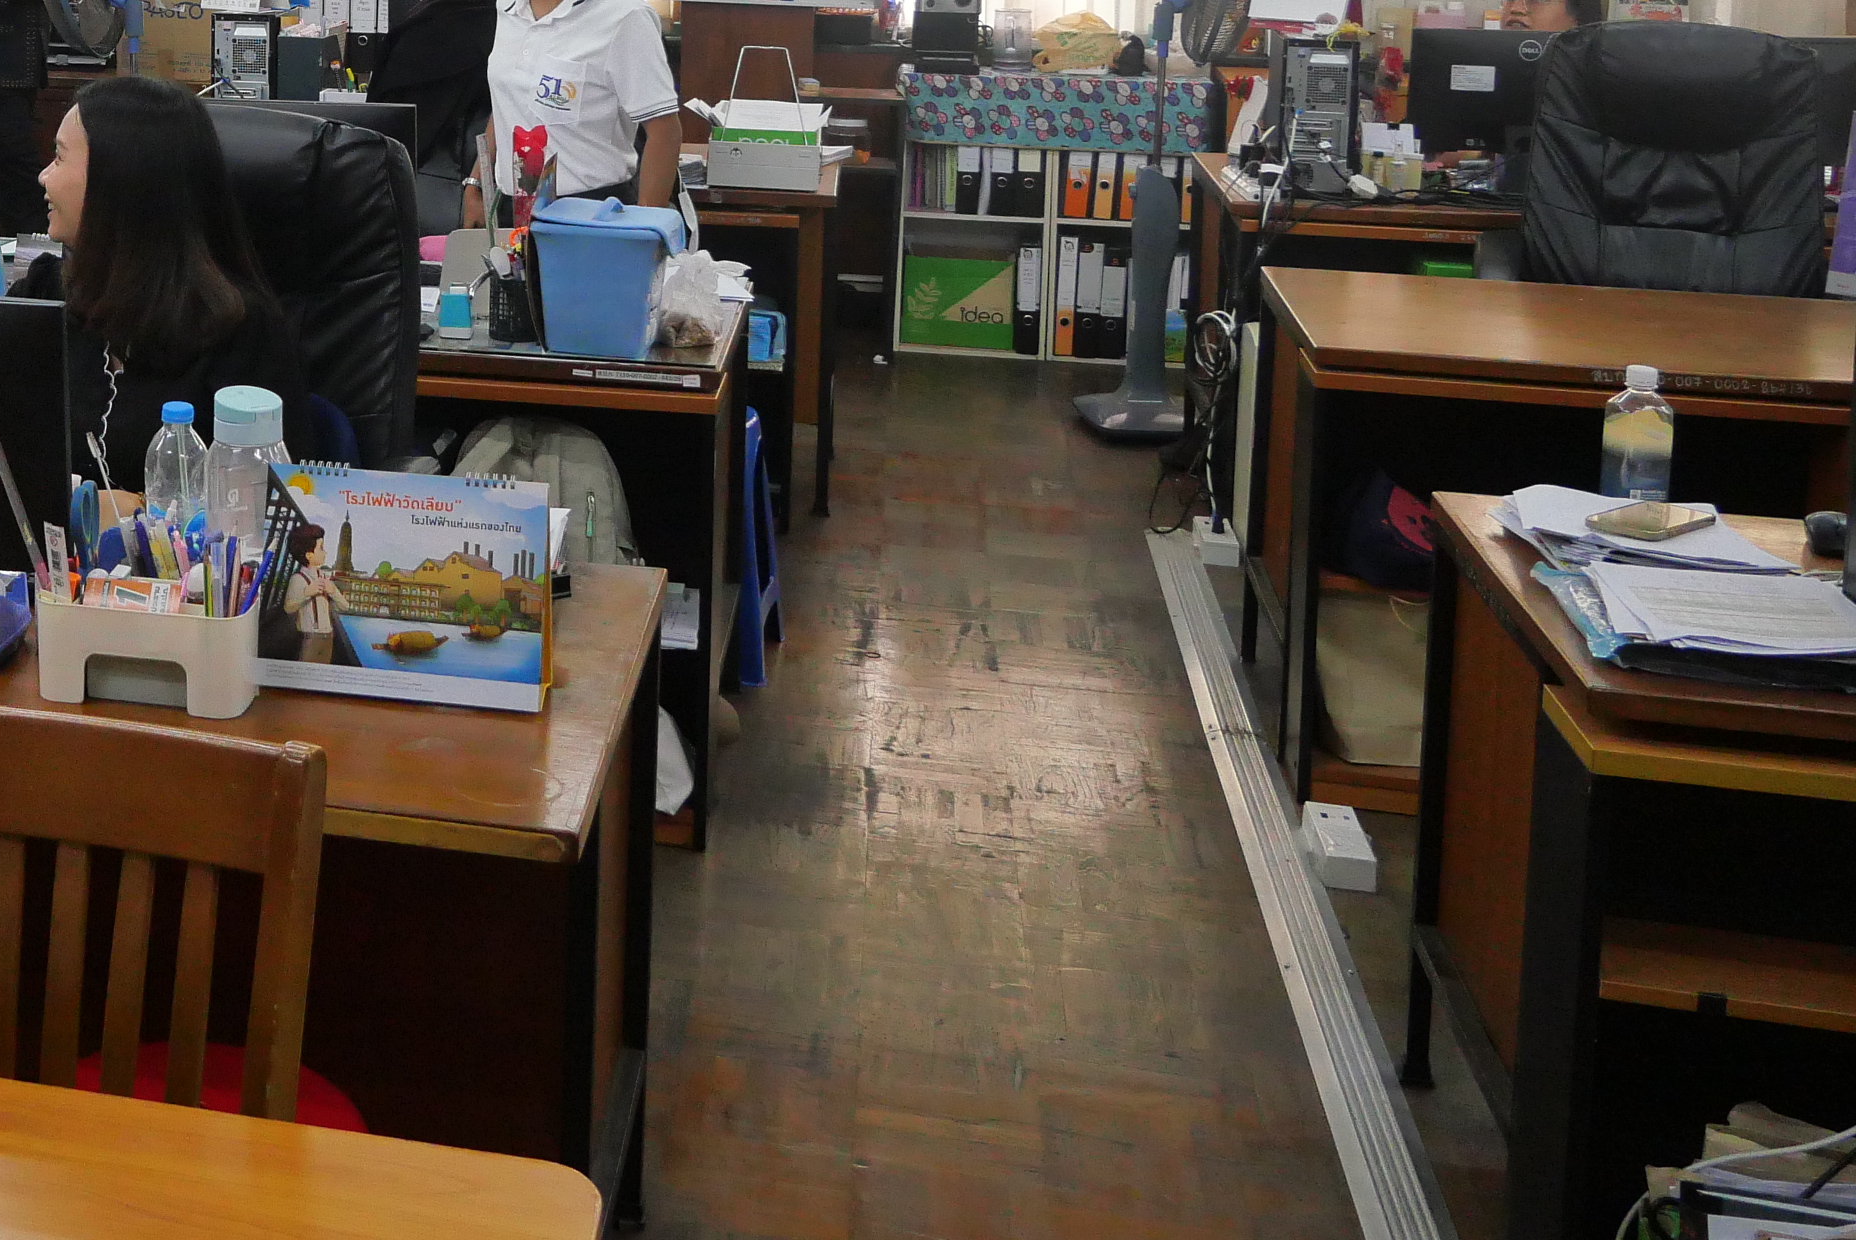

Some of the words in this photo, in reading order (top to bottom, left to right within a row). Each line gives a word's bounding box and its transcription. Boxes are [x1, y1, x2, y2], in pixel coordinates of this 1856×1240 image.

[536, 73, 563, 99] 51
[959, 305, 1005, 324] idea
[410, 513, 523, 534] โรงไฟฟ้าแห่งแรกของไทย
